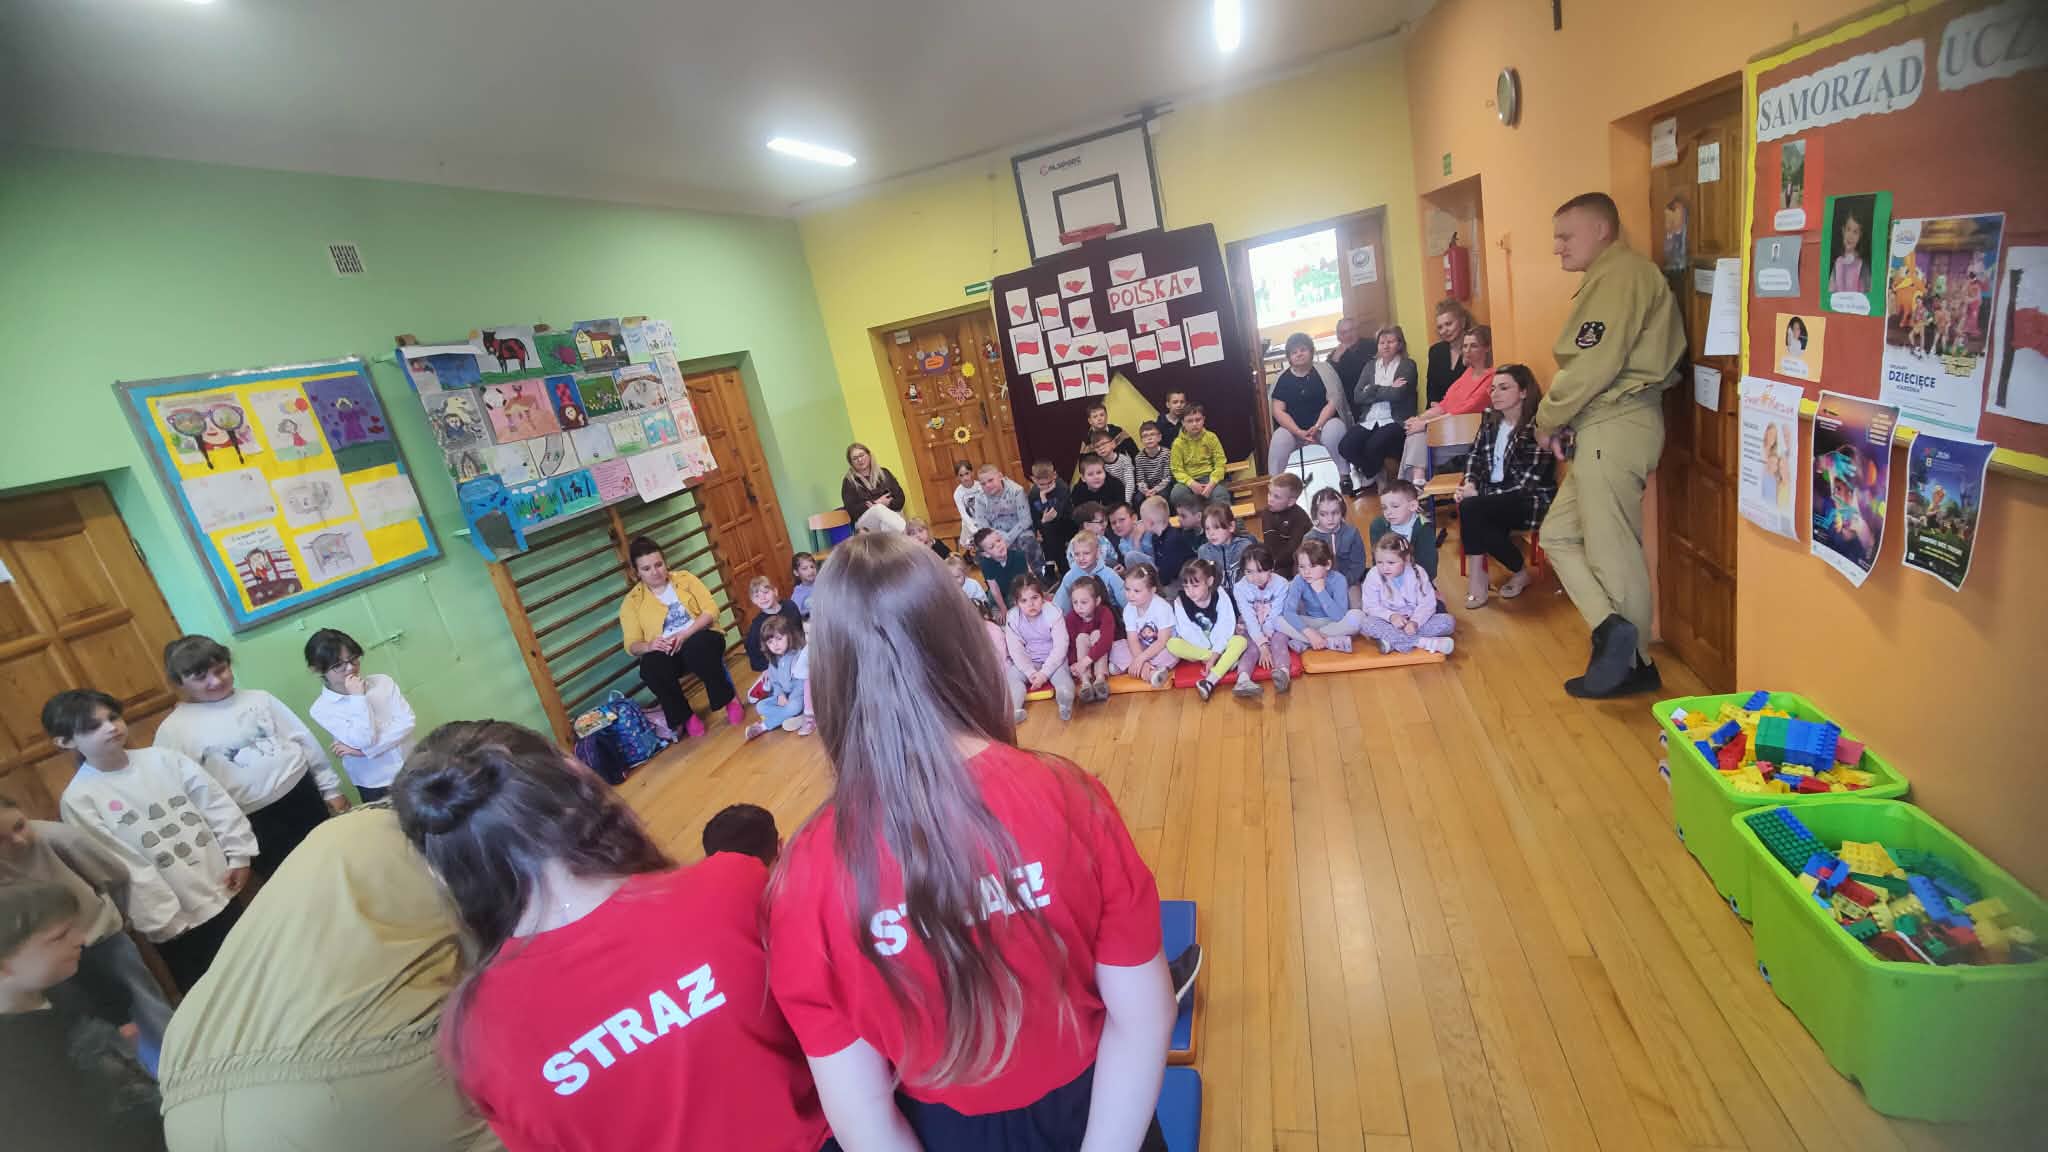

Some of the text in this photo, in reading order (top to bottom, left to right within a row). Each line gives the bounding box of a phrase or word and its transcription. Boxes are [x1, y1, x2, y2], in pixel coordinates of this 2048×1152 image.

[1759, 55, 1923, 132] SAMORZĄD
[1109, 272, 1183, 311] POLSKA
[1888, 370, 1937, 390] DZIECIĘCE
